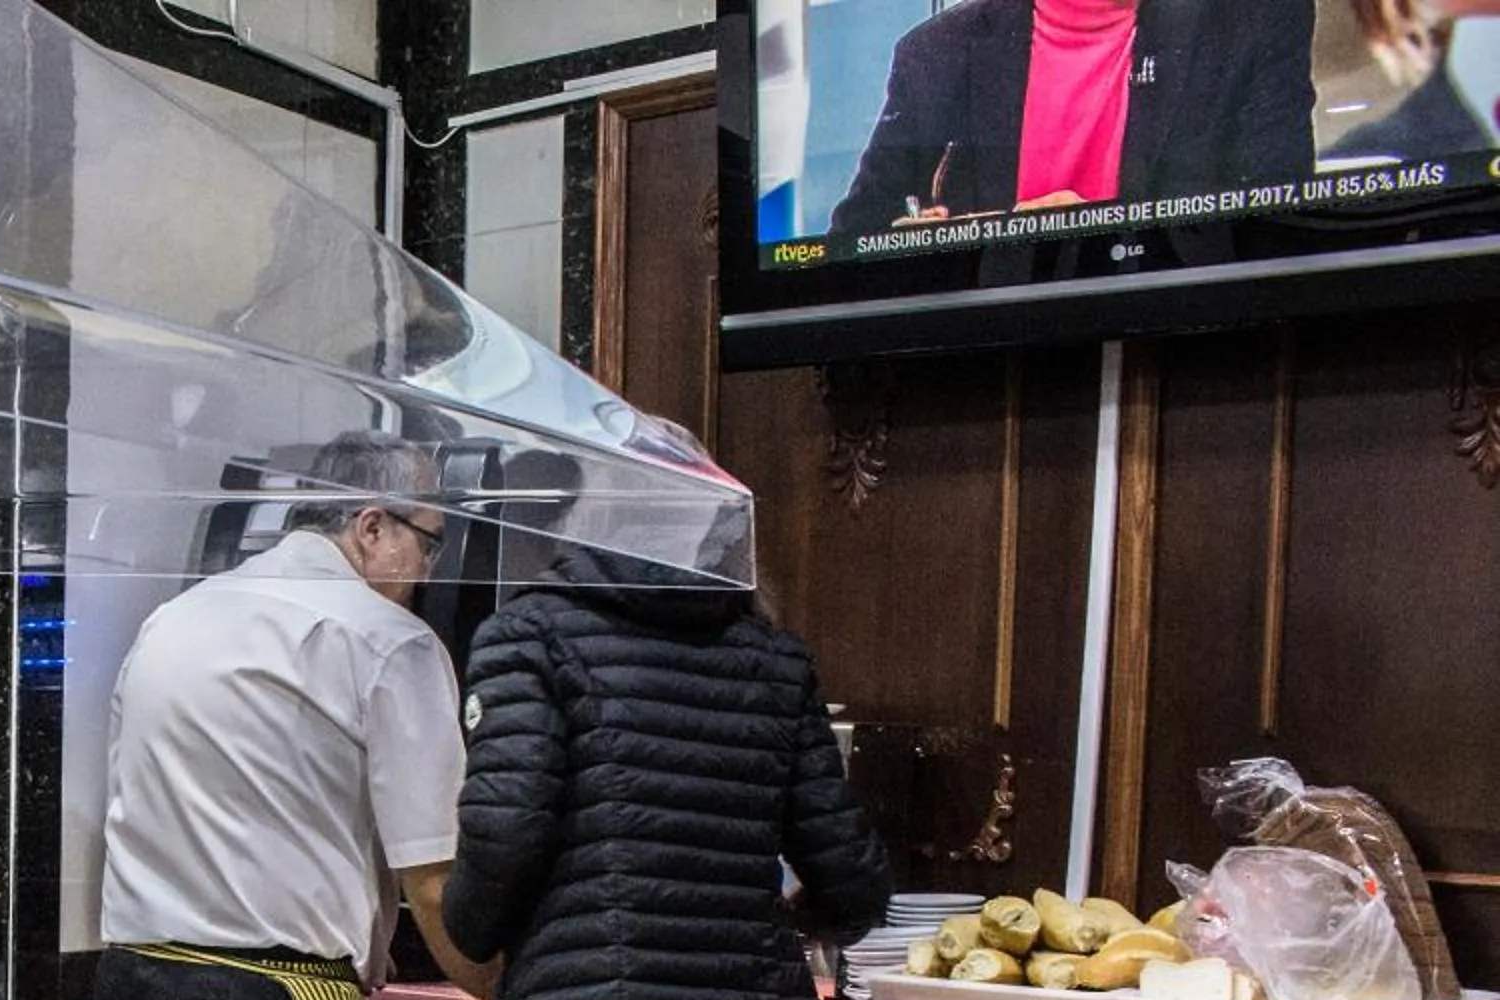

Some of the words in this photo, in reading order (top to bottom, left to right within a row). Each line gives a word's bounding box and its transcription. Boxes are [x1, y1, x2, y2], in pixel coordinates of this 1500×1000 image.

[857, 231, 932, 254] SAMSUNG
[935, 223, 980, 244] GANÓ
[983, 217, 1037, 239] 31.670
[1040, 206, 1125, 233] MILLONES
[1128, 201, 1153, 222] DE
[1156, 196, 1215, 217] EUROS
[1220, 190, 1245, 211] EN
[1250, 185, 1299, 207] 2017,
[1303, 179, 1332, 200] UN
[1336, 173, 1394, 197] 85,6%
[1398, 162, 1445, 188] MÁS
[1128, 244, 1145, 257] LG
